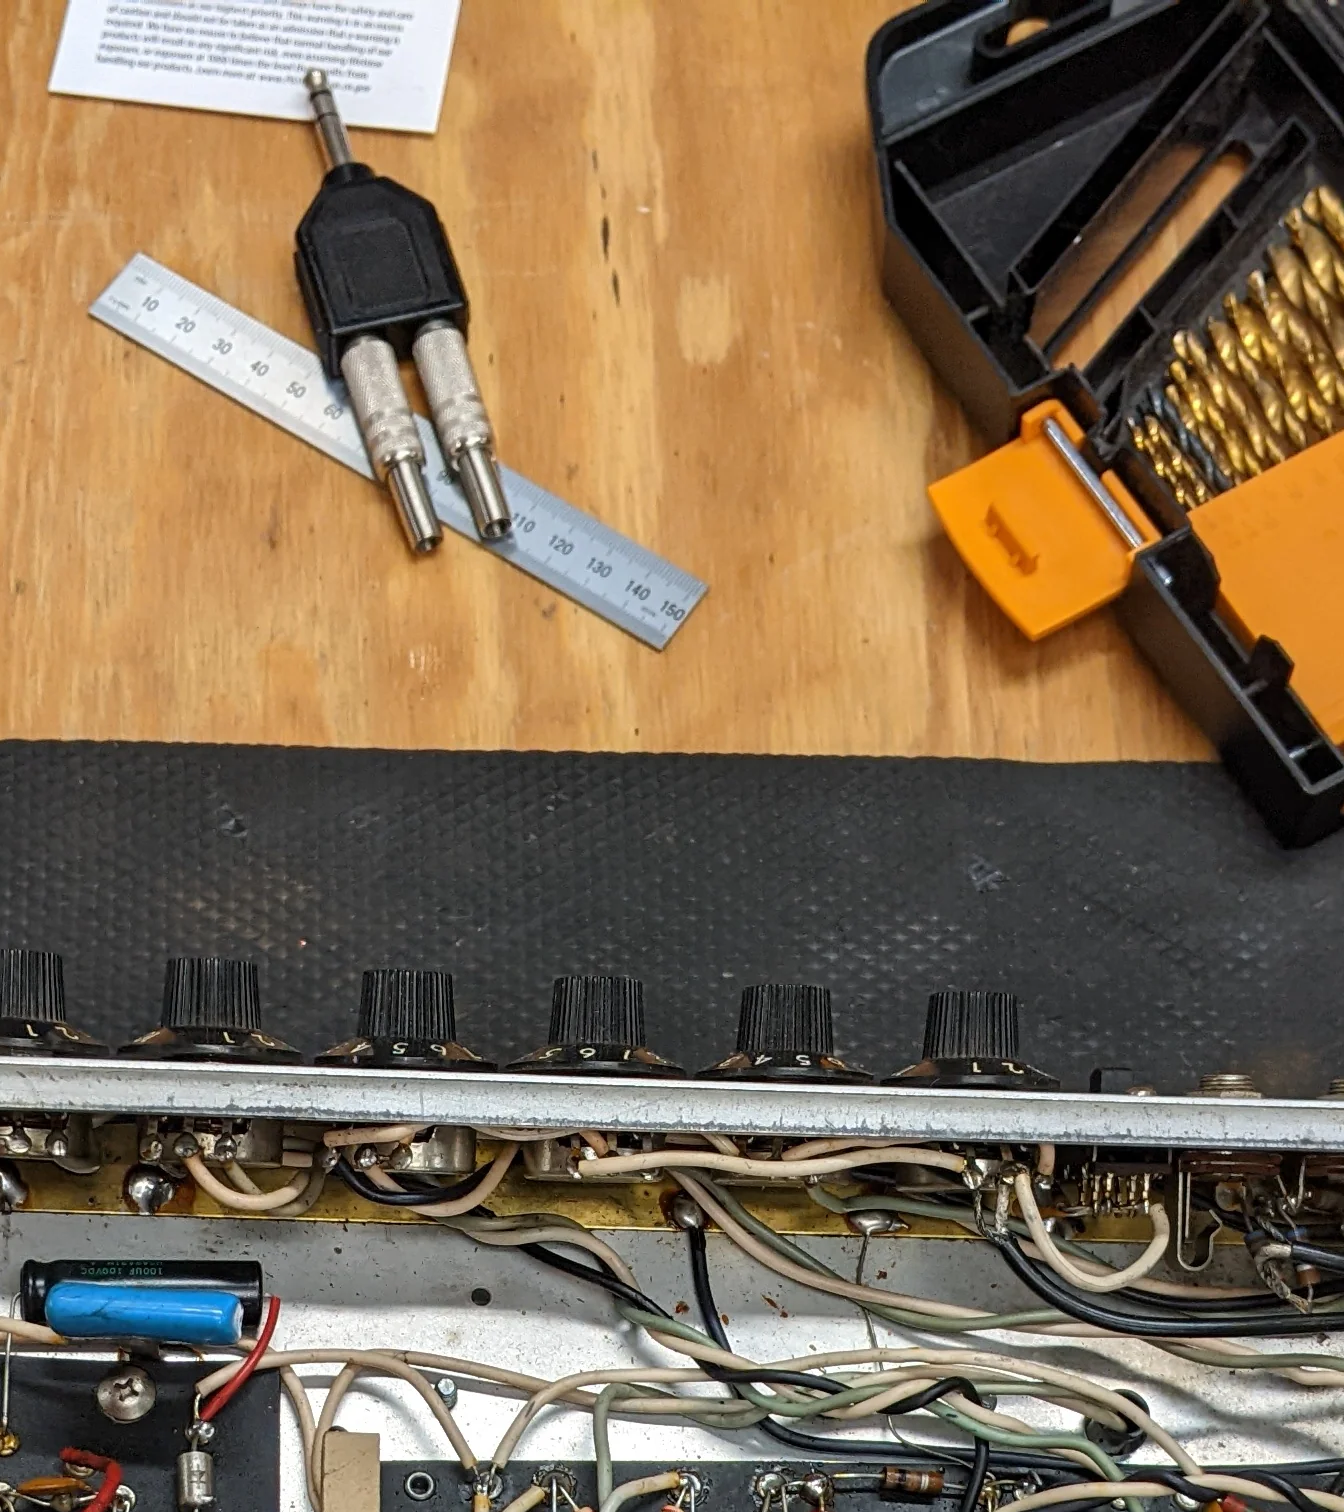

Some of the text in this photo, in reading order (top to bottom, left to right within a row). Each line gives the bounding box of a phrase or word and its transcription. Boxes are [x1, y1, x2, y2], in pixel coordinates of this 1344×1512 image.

[142, 296, 160, 312] 10
[175, 316, 196, 333] 20
[212, 338, 233, 355] 30
[250, 360, 270, 378] 40
[286, 382, 306, 399] 50
[323, 404, 343, 420] 60
[548, 535, 574, 556] 120
[586, 557, 612, 578] 130
[624, 580, 652, 601] 140
[660, 600, 686, 622] 150
[128, 1266, 163, 1275] 100UF
